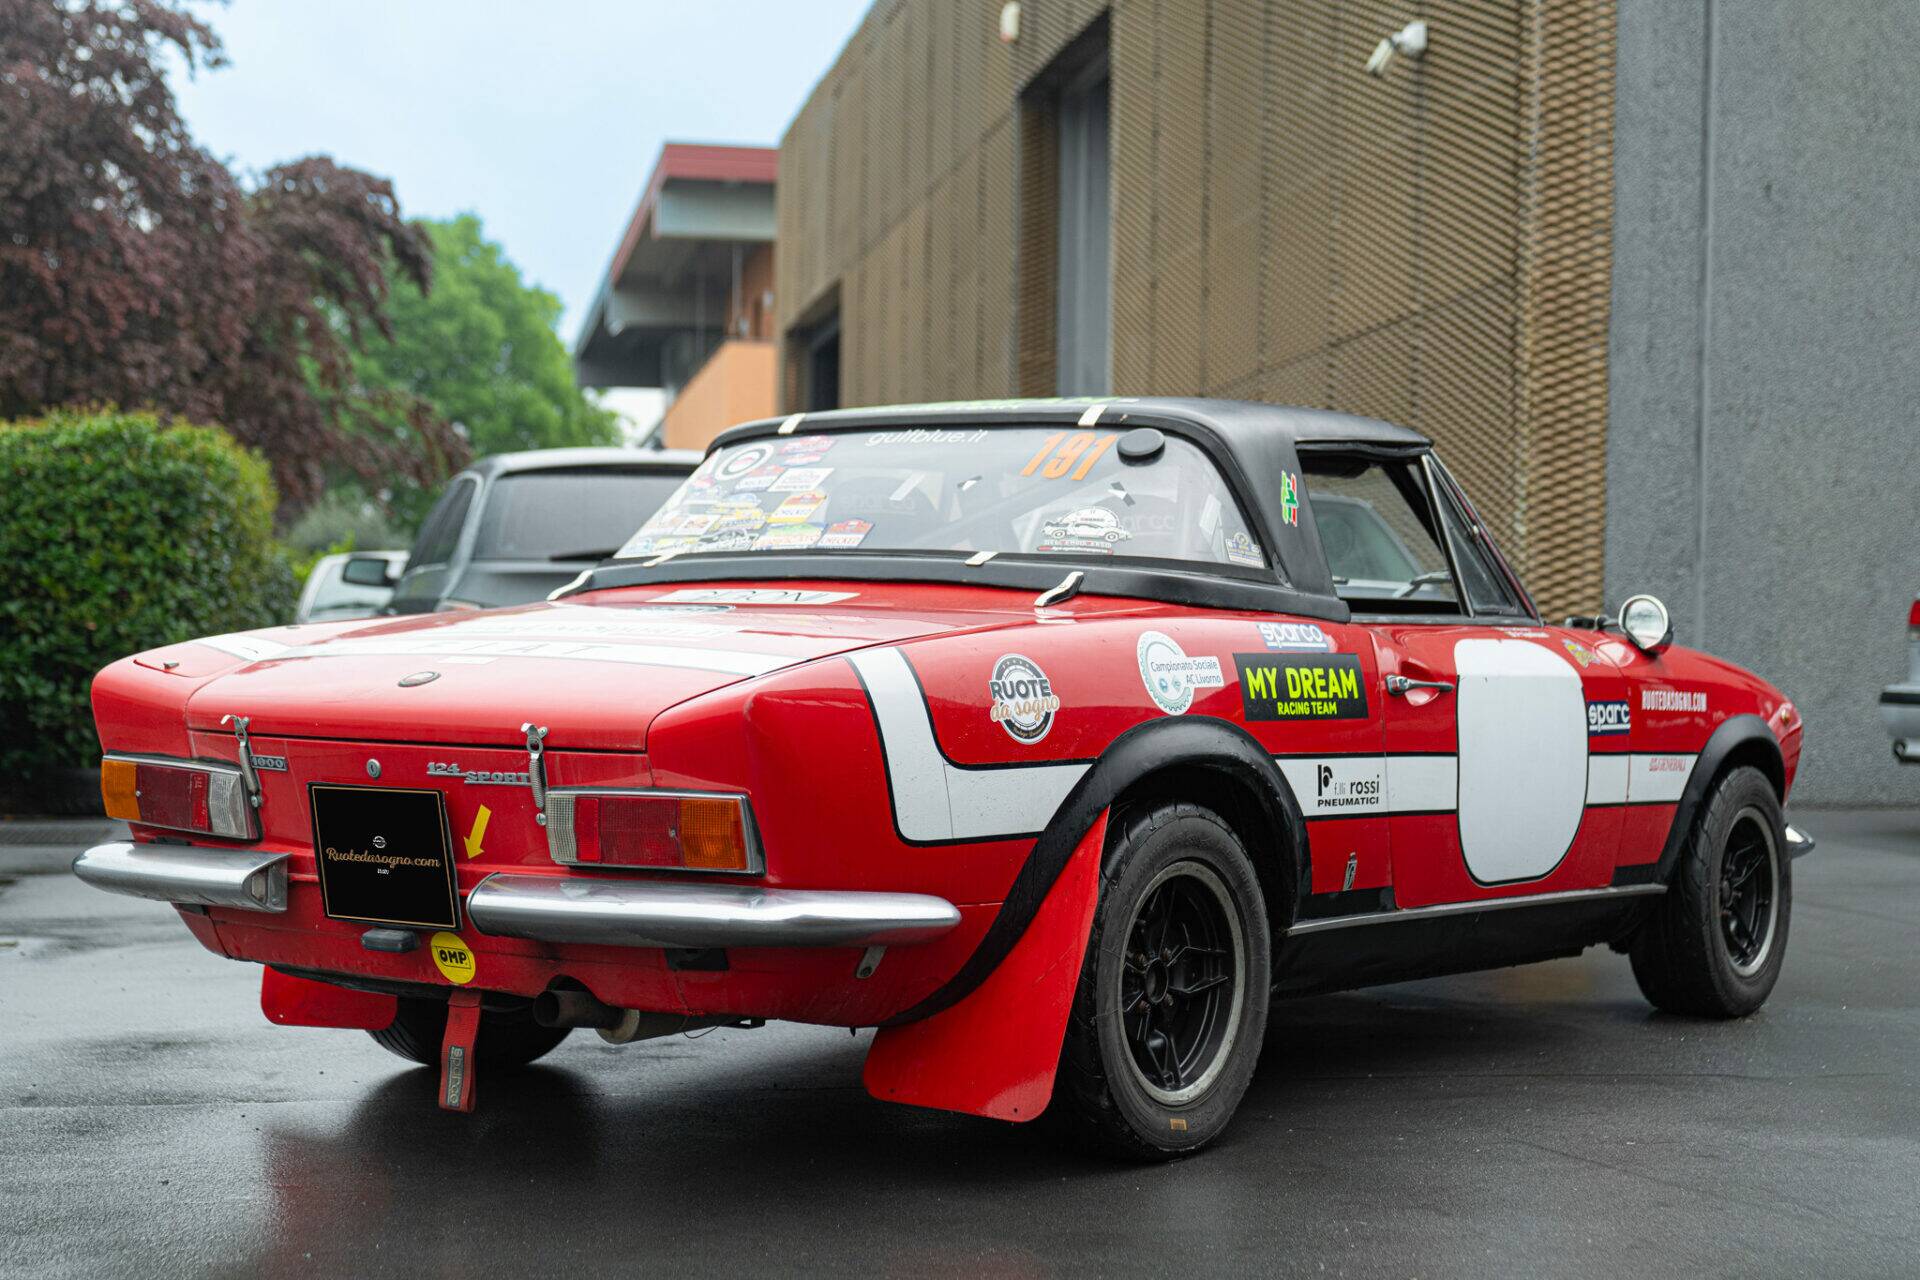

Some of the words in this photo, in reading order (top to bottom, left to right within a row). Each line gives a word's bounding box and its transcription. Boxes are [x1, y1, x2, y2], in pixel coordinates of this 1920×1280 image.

[864, 429, 988, 447] gulfblue.it
[1022, 431, 1118, 481] 191
[1258, 623, 1323, 647] sparco
[1150, 659, 1193, 673] Campionato
[1193, 660, 1218, 671] Sociale
[1187, 676, 1197, 685] AC
[1197, 674, 1222, 685] Livorno
[1246, 667, 1278, 700] MY
[1286, 667, 1359, 700] DREAM
[989, 679, 1052, 701] RUOTE
[991, 701, 1011, 721] da
[1014, 696, 1060, 722] sogno
[1277, 701, 1310, 716] RACING
[1311, 701, 1338, 715] TEAM
[426, 761, 461, 776] 124
[464, 770, 532, 785] SPORT
[1350, 774, 1380, 795] rossi
[1317, 796, 1379, 808] PNEUMATICI
[325, 847, 441, 869] Ruotedasogno.com
[439, 949, 468, 966] OMP
